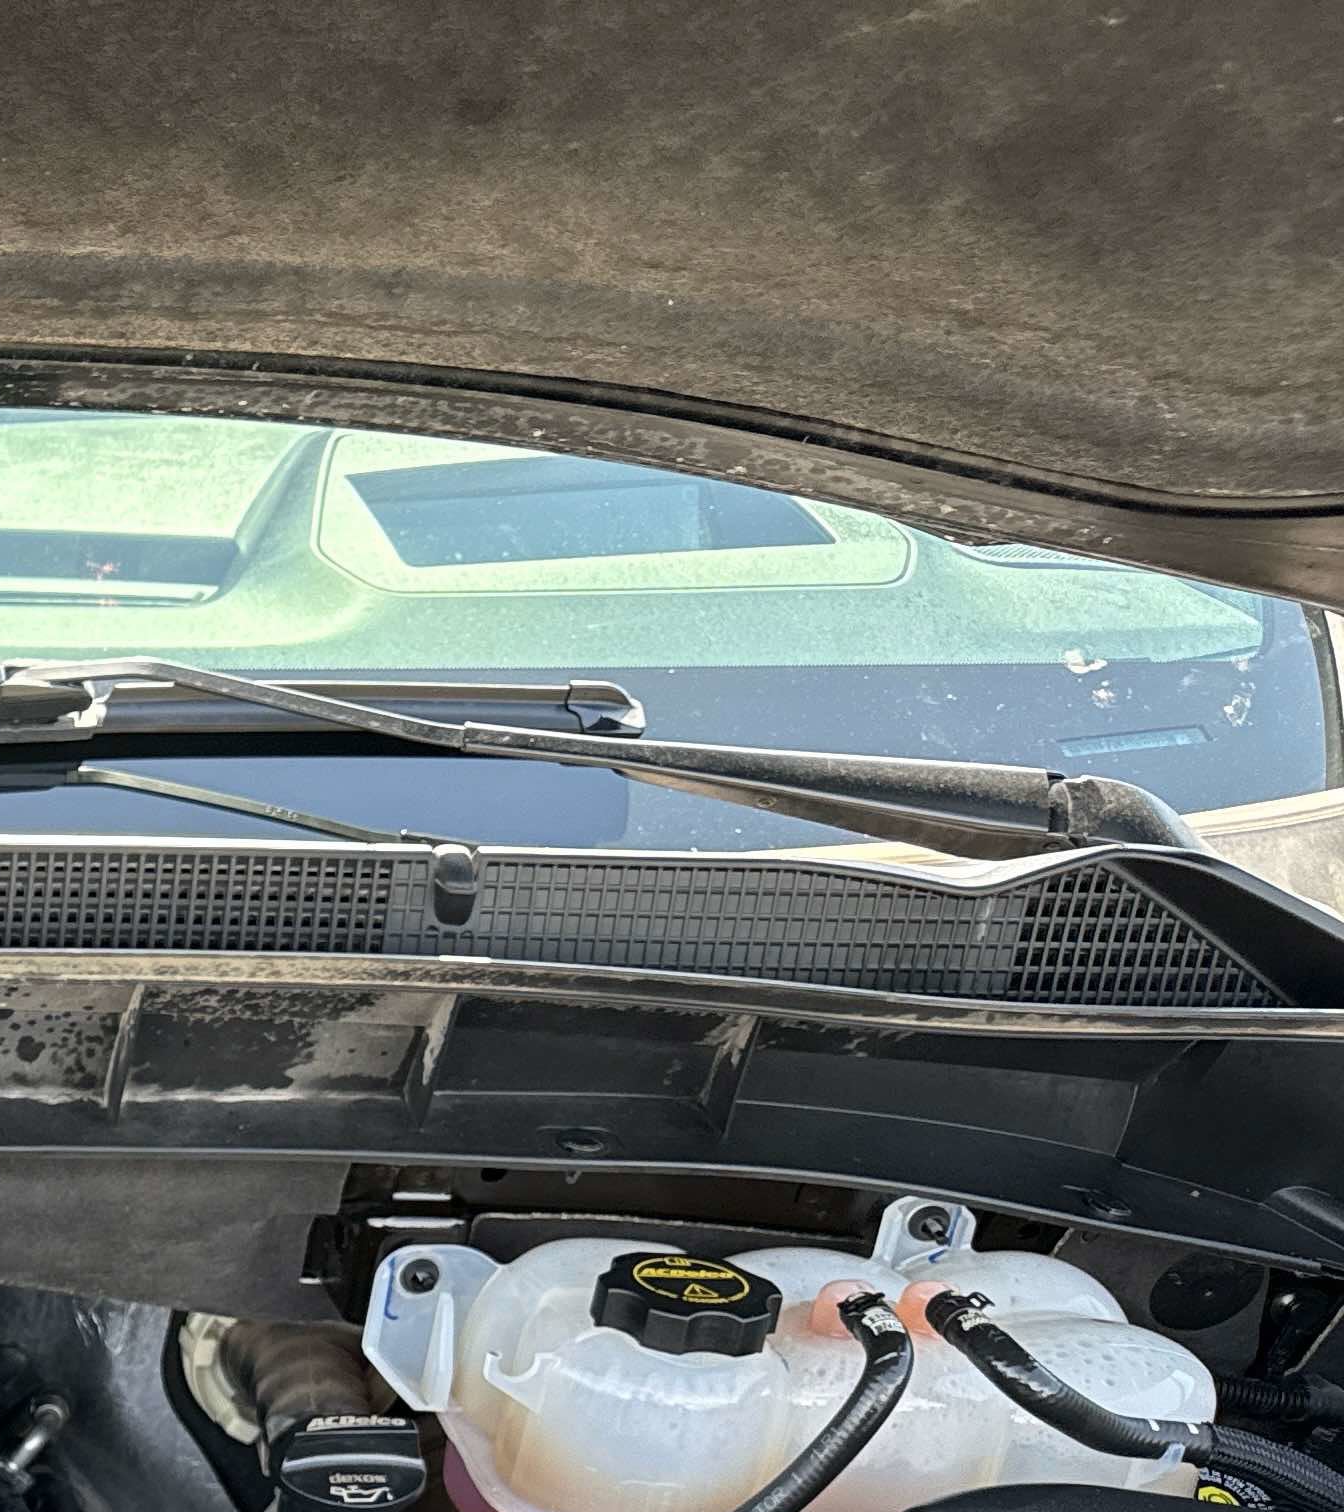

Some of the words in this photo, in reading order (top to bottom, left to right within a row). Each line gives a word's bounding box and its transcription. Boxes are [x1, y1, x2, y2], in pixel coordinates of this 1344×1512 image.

[637, 1267, 736, 1279] ACDelco
[306, 1415, 407, 1432] ACDelco
[328, 1472, 387, 1484] dexos
